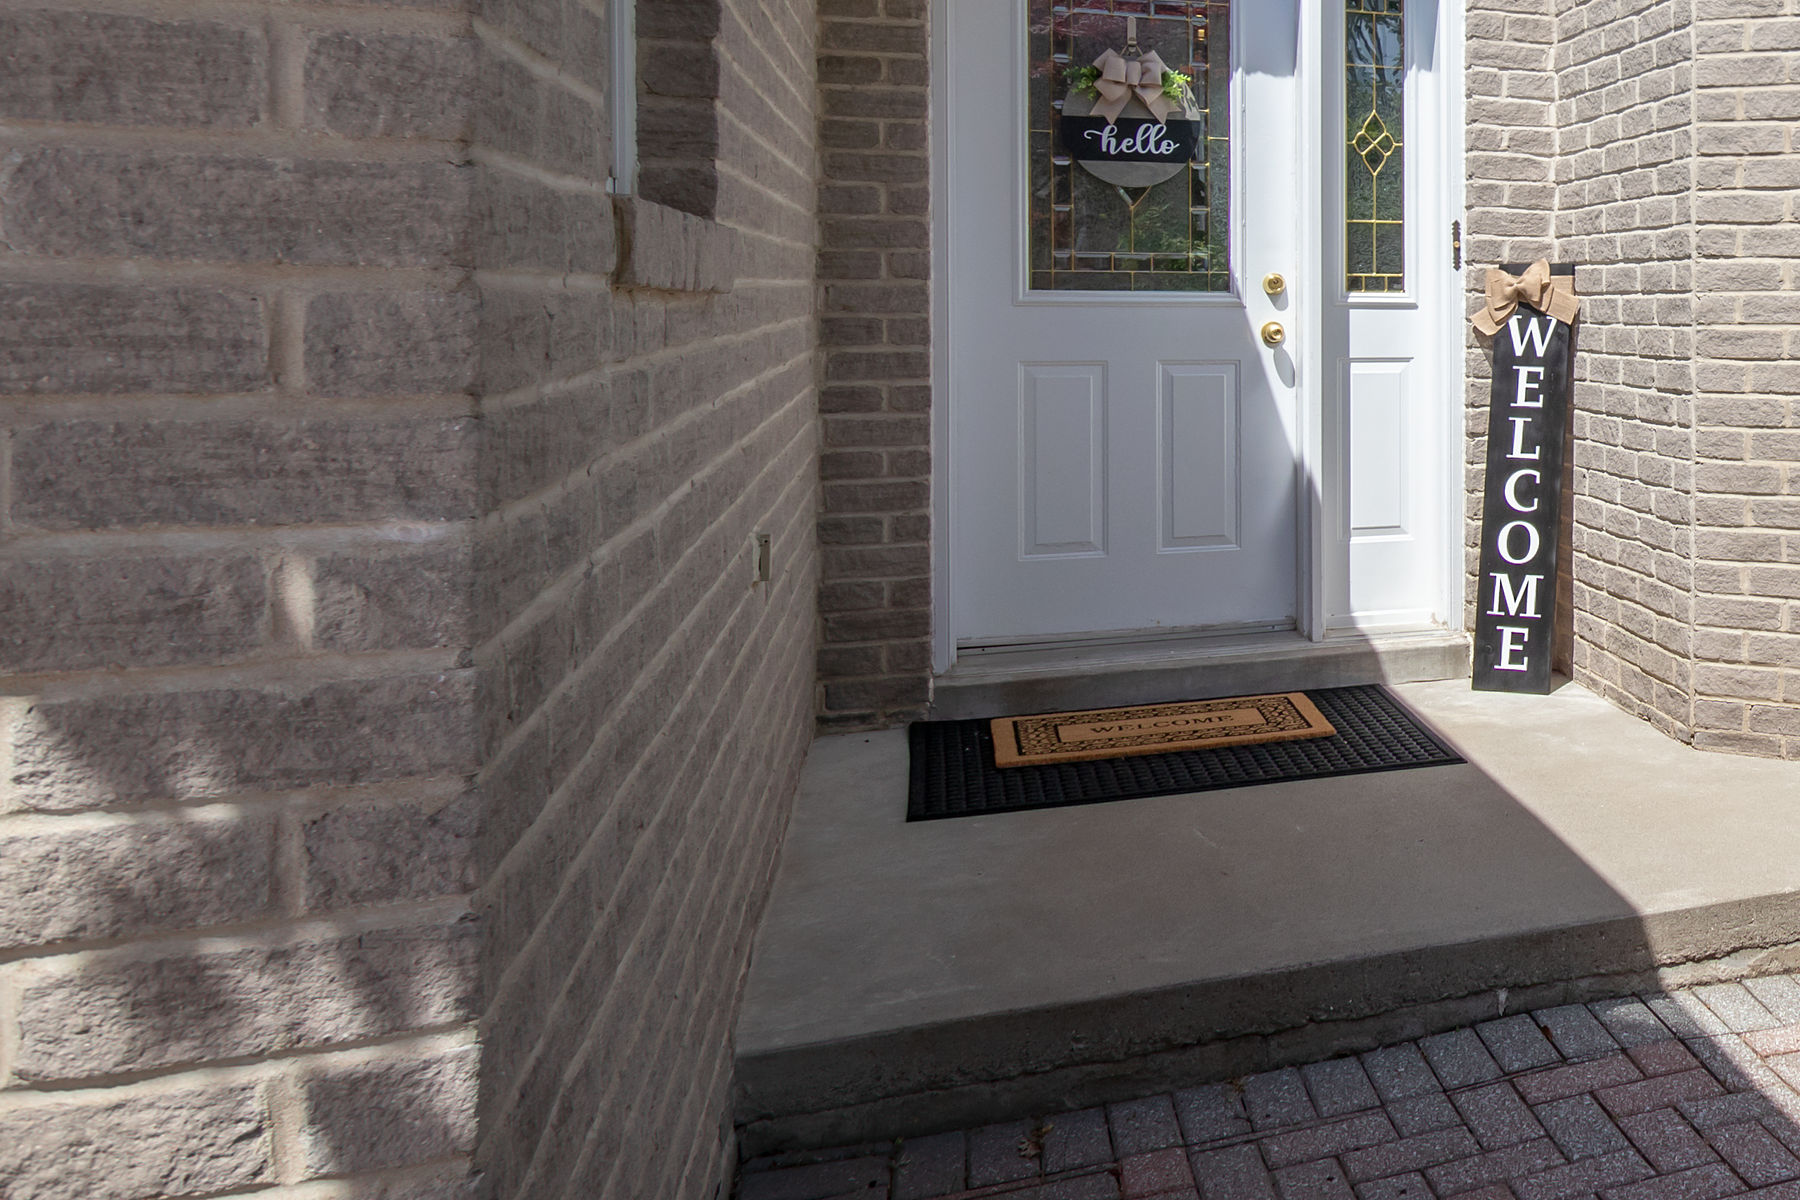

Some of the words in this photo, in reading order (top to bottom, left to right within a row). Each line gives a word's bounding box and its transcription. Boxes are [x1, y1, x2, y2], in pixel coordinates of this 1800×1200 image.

[1084, 124, 1180, 155] hello
[1486, 315, 1557, 672] WELCOME
[1091, 715, 1234, 734] WELCOME
